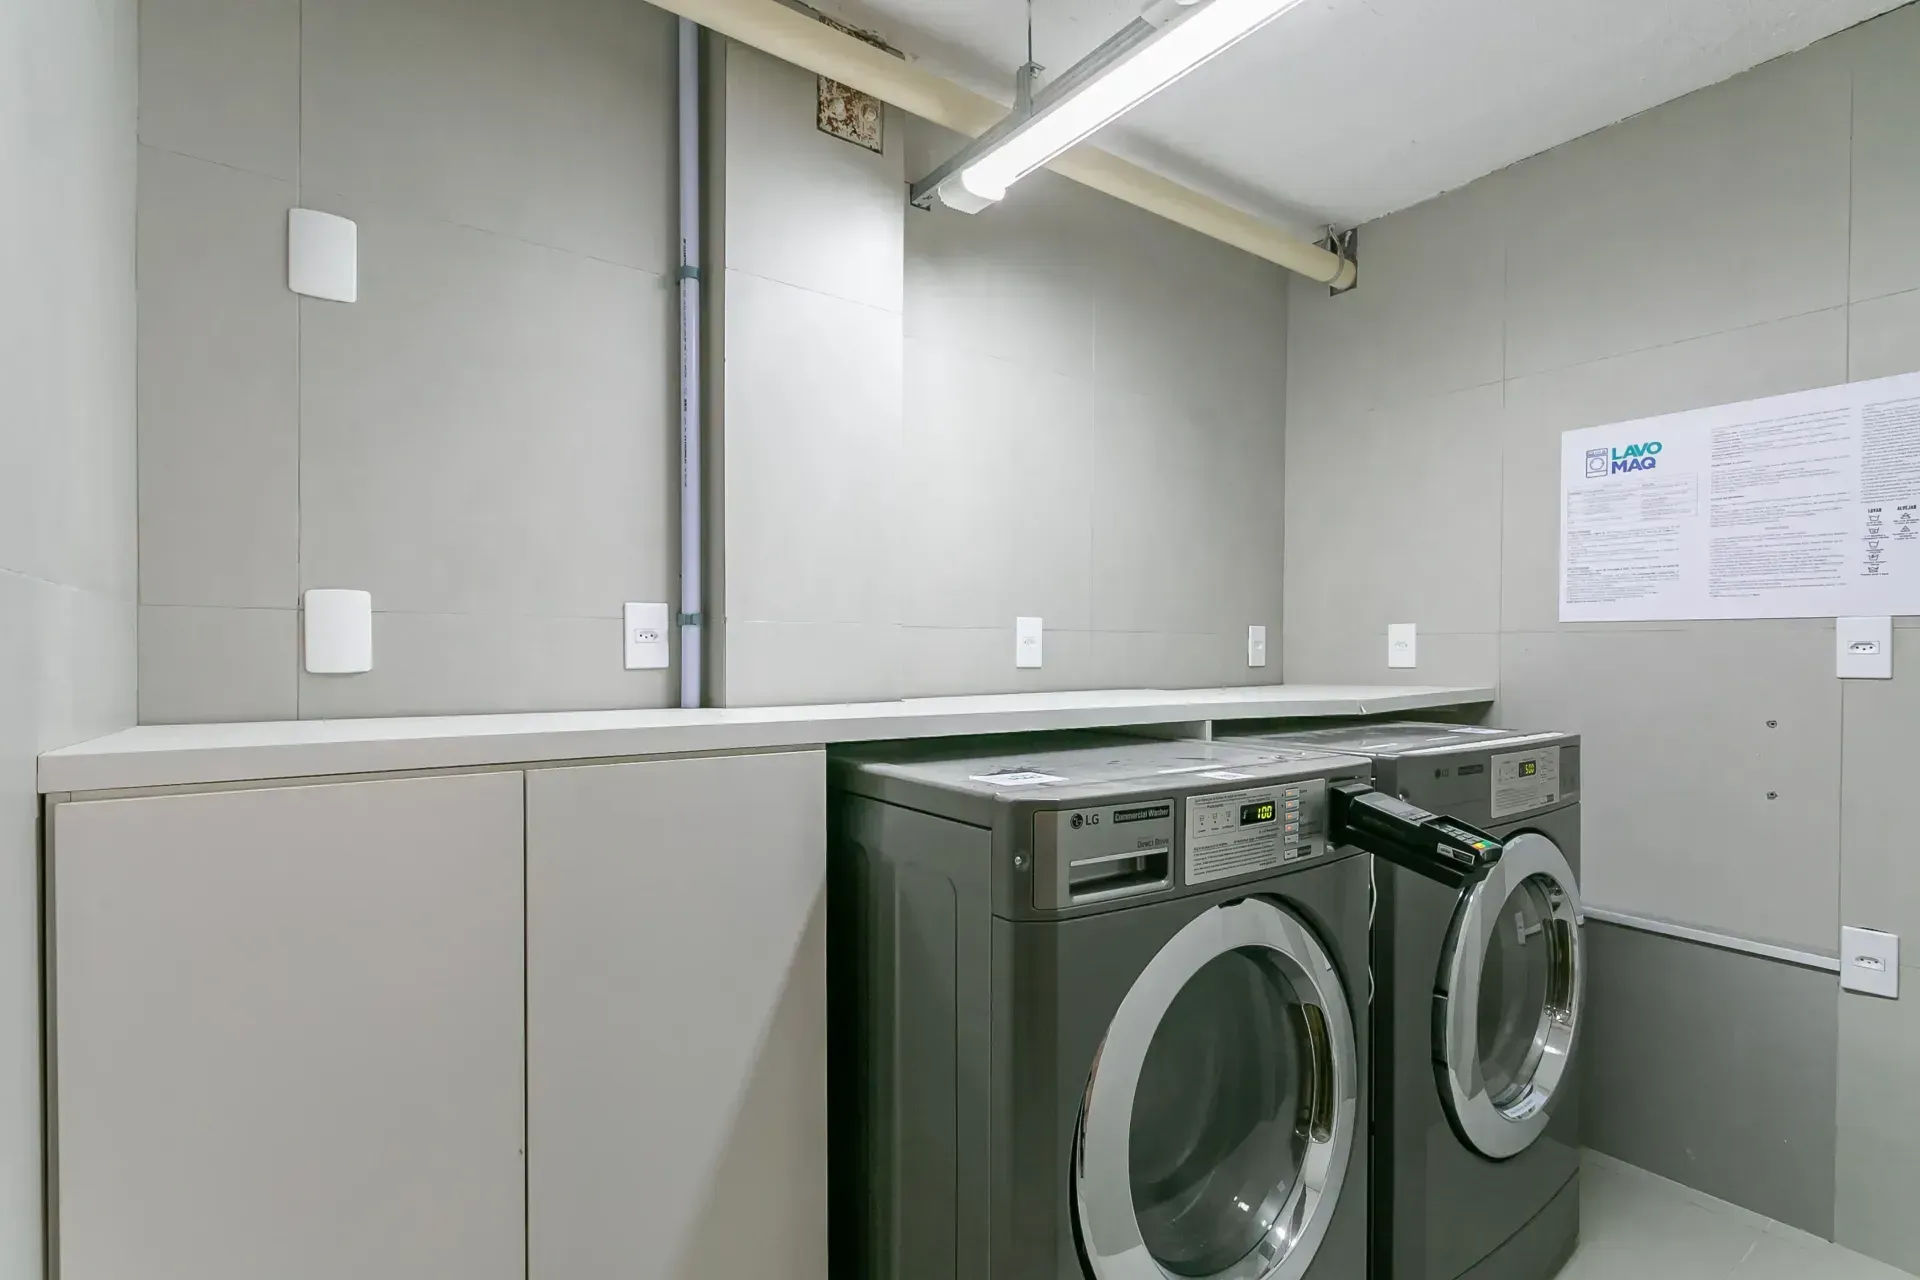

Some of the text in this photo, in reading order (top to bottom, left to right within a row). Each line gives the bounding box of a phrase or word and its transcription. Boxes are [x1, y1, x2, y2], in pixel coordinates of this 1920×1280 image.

[1612, 441, 1662, 460] LAVO
[1612, 457, 1656, 474] MAQ
[1115, 807, 1169, 821] Commercial Washer
[1257, 805, 1273, 819] 100
[1086, 814, 1099, 826] LG
